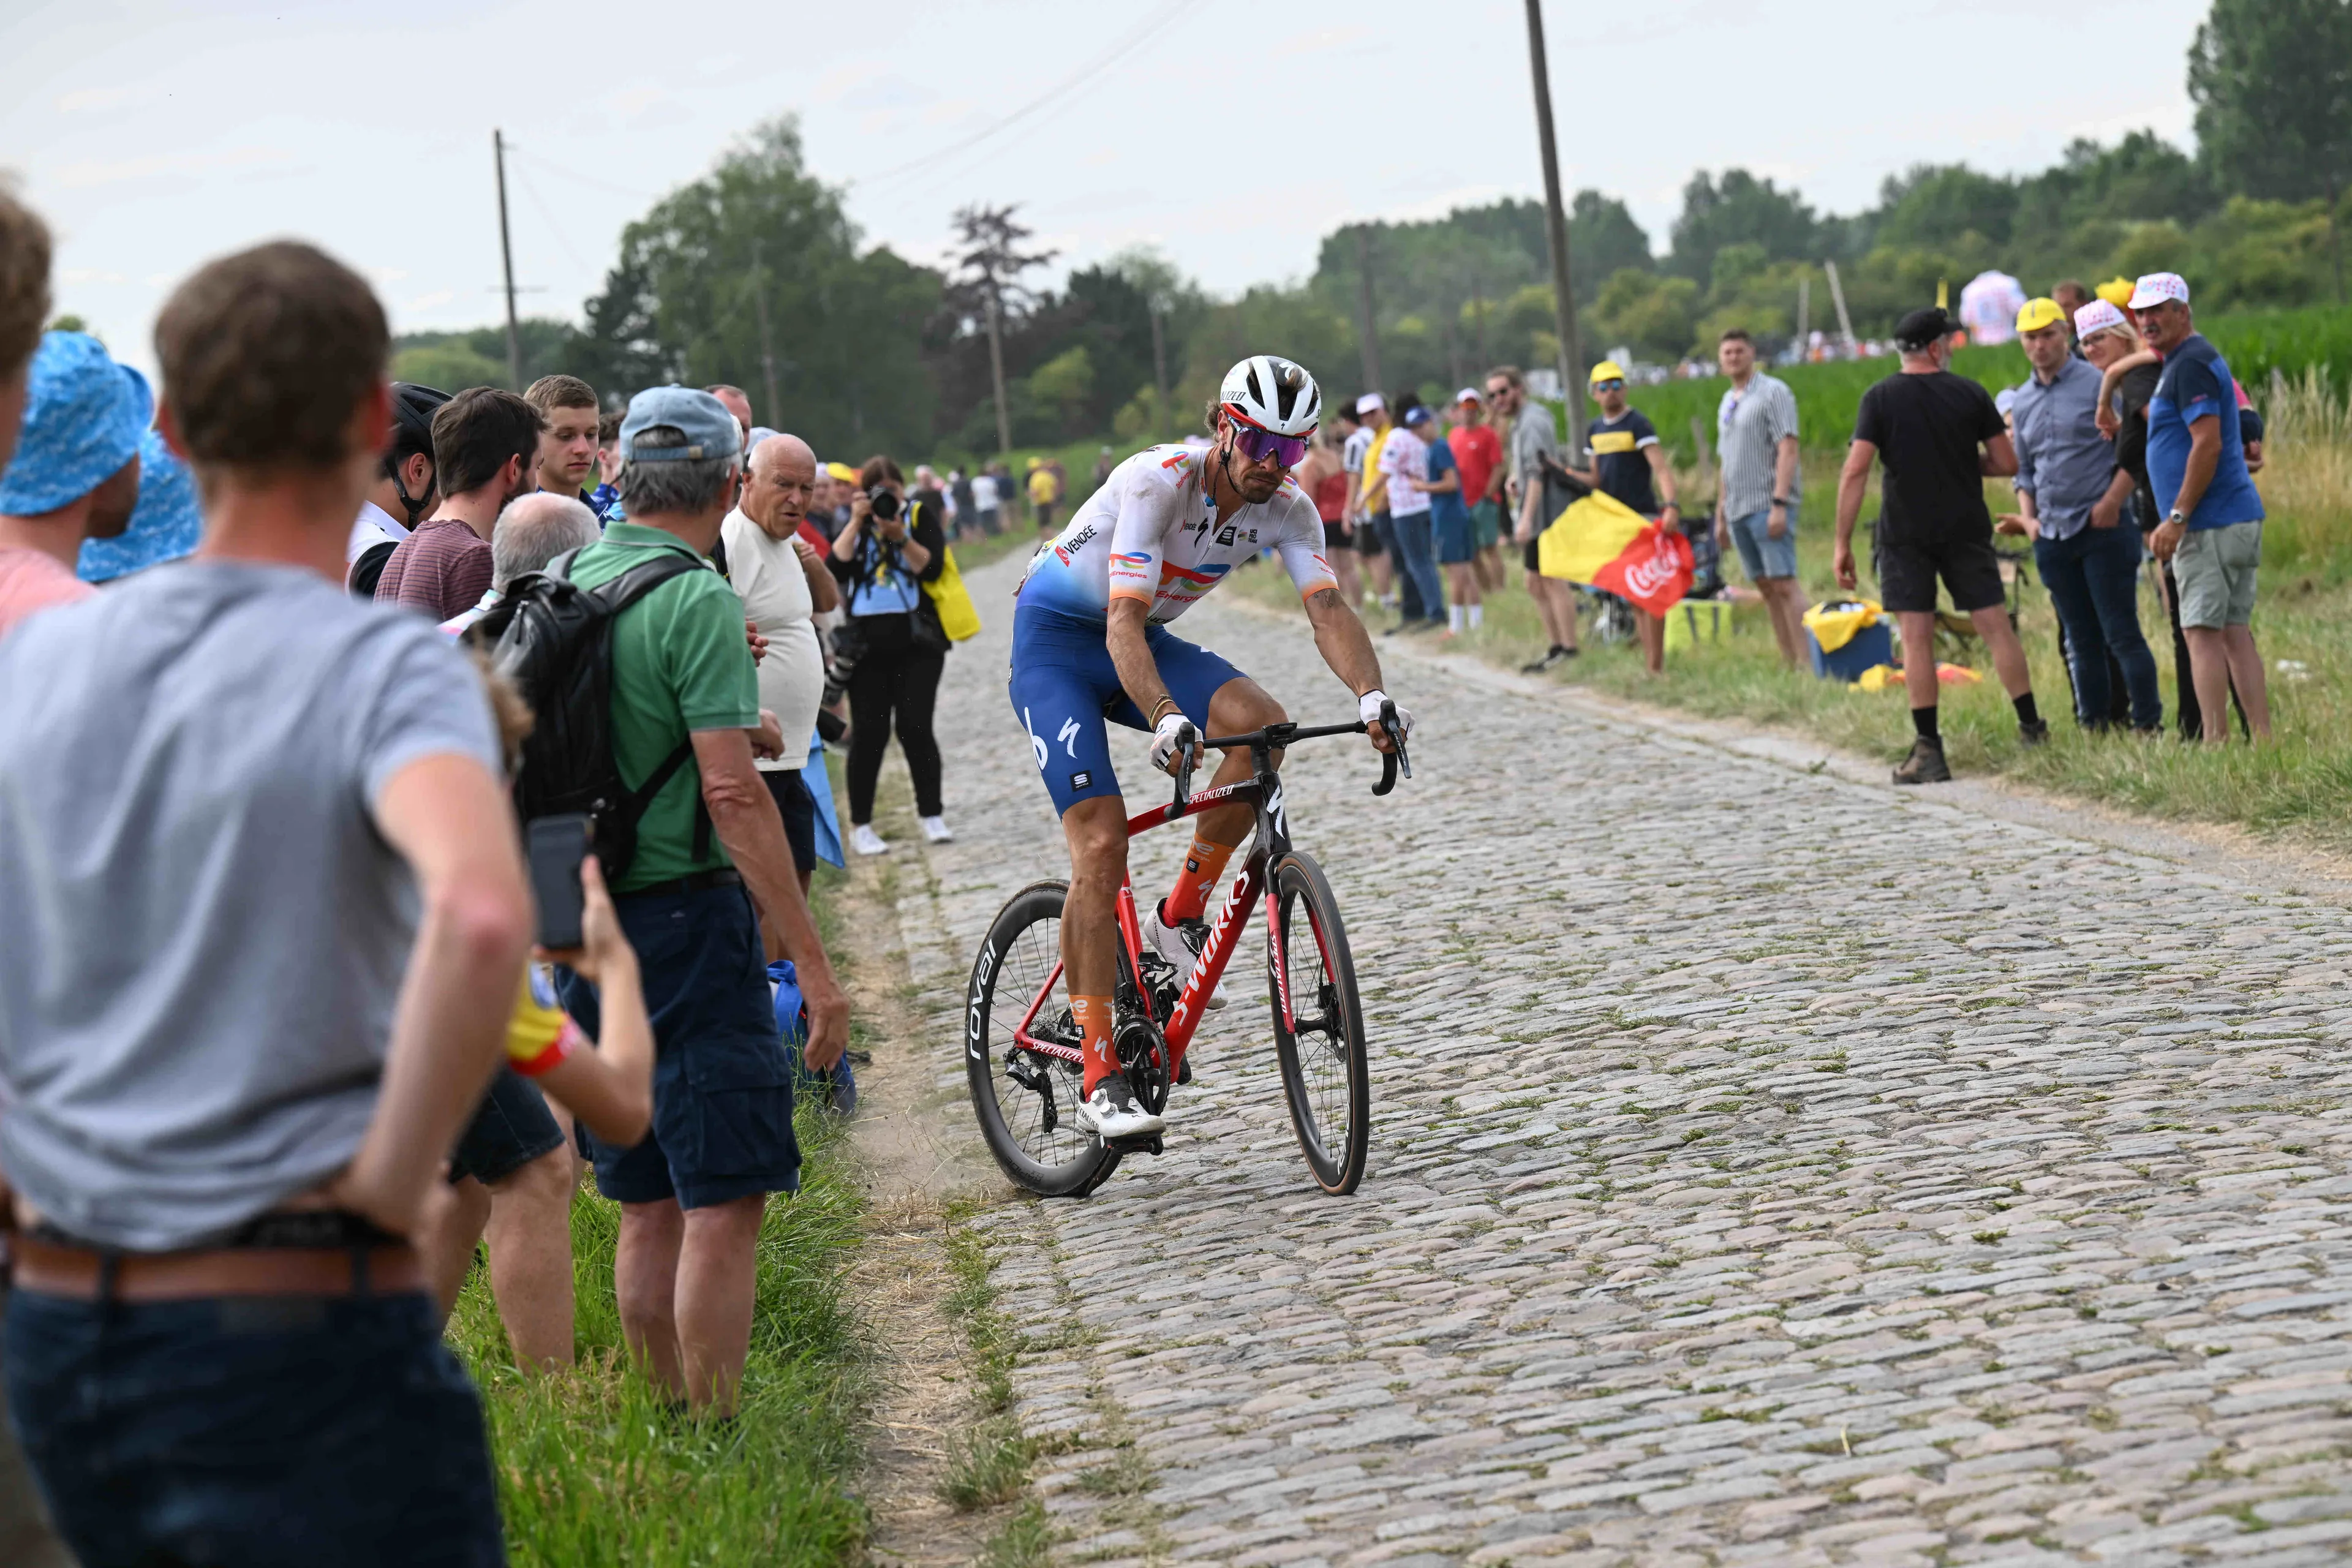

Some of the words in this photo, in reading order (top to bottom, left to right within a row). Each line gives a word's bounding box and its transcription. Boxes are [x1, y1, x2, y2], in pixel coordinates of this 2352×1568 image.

[1064, 524, 1098, 554] VENDÉE
[1188, 785, 1235, 805] SPECIALIZED
[1174, 870, 1250, 1027] S-WORKS
[1271, 934, 1287, 1014] SPECIALIZED
[970, 938, 997, 1060] roval
[1030, 1041, 1085, 1064] SPECIALIZED
